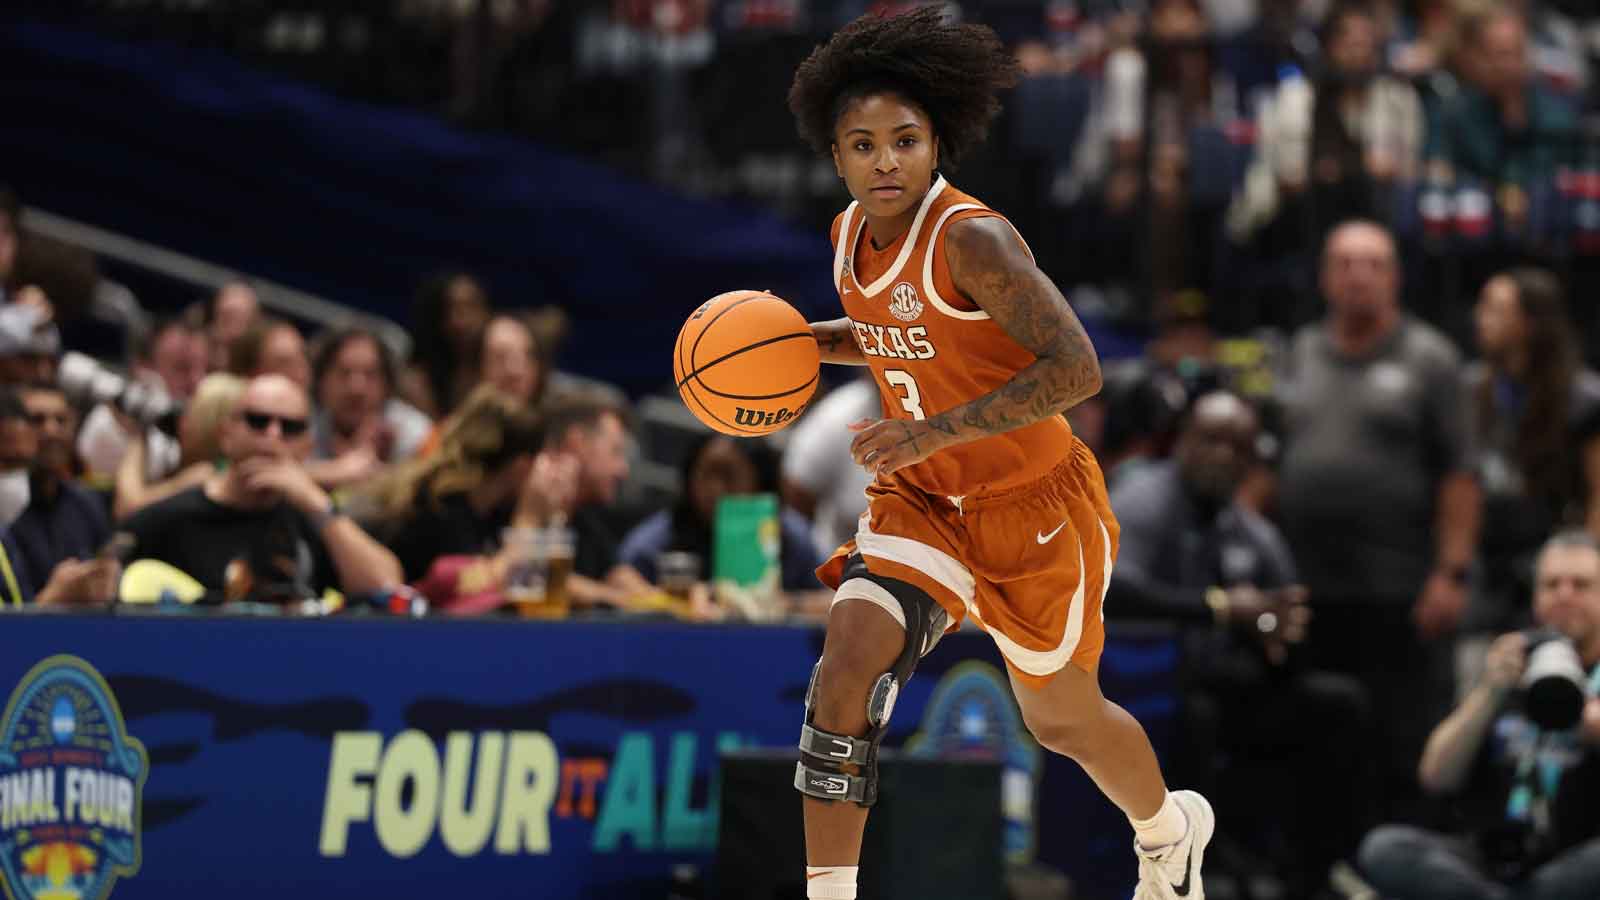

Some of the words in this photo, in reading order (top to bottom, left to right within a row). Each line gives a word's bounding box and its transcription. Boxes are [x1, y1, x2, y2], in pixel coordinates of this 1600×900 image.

[891, 283, 918, 313] SEC
[0, 766, 60, 832] INAL
[64, 766, 135, 835] FOUR
[319, 728, 559, 858] FOUR
[556, 757, 608, 818] IT
[592, 730, 741, 853] AL
